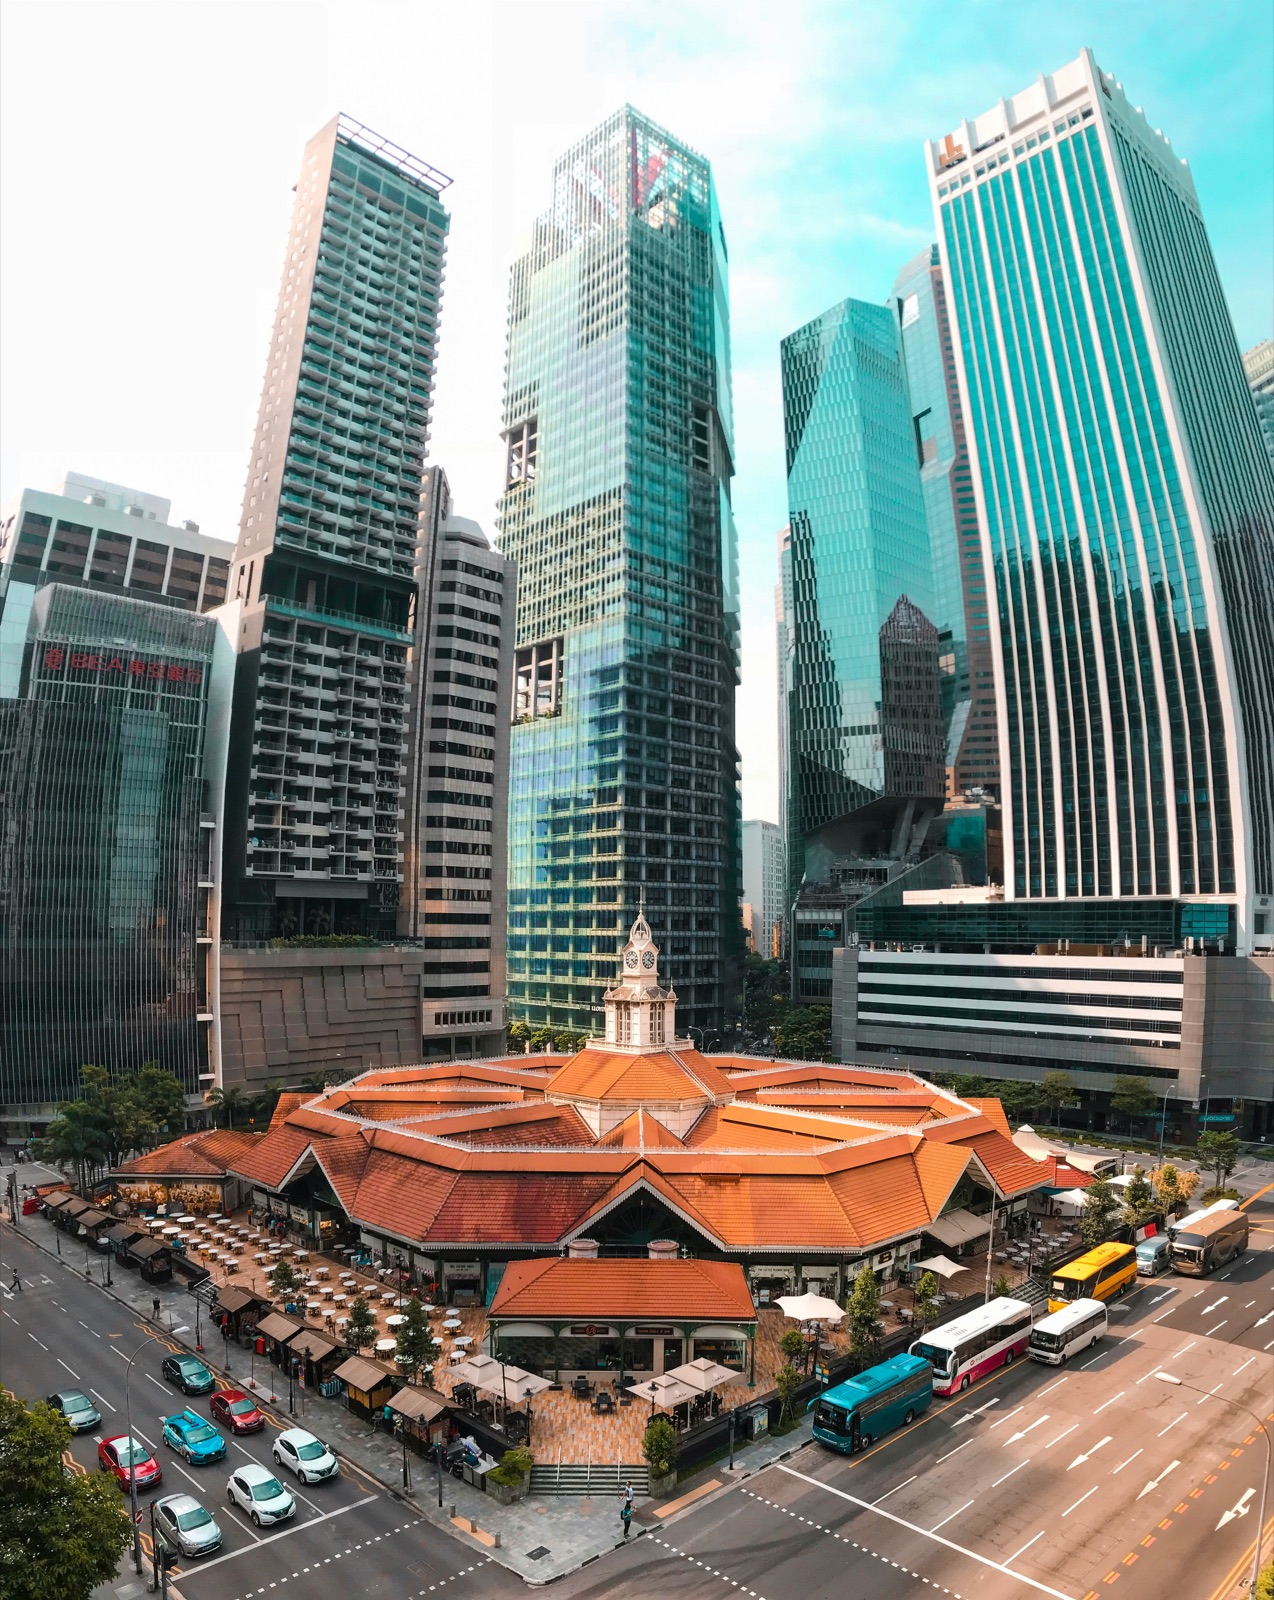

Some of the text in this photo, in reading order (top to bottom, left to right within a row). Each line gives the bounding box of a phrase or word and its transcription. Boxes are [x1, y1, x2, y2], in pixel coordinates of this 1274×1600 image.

[71, 653, 124, 673] BEA
[129, 659, 203, 685] 東亞銀行
